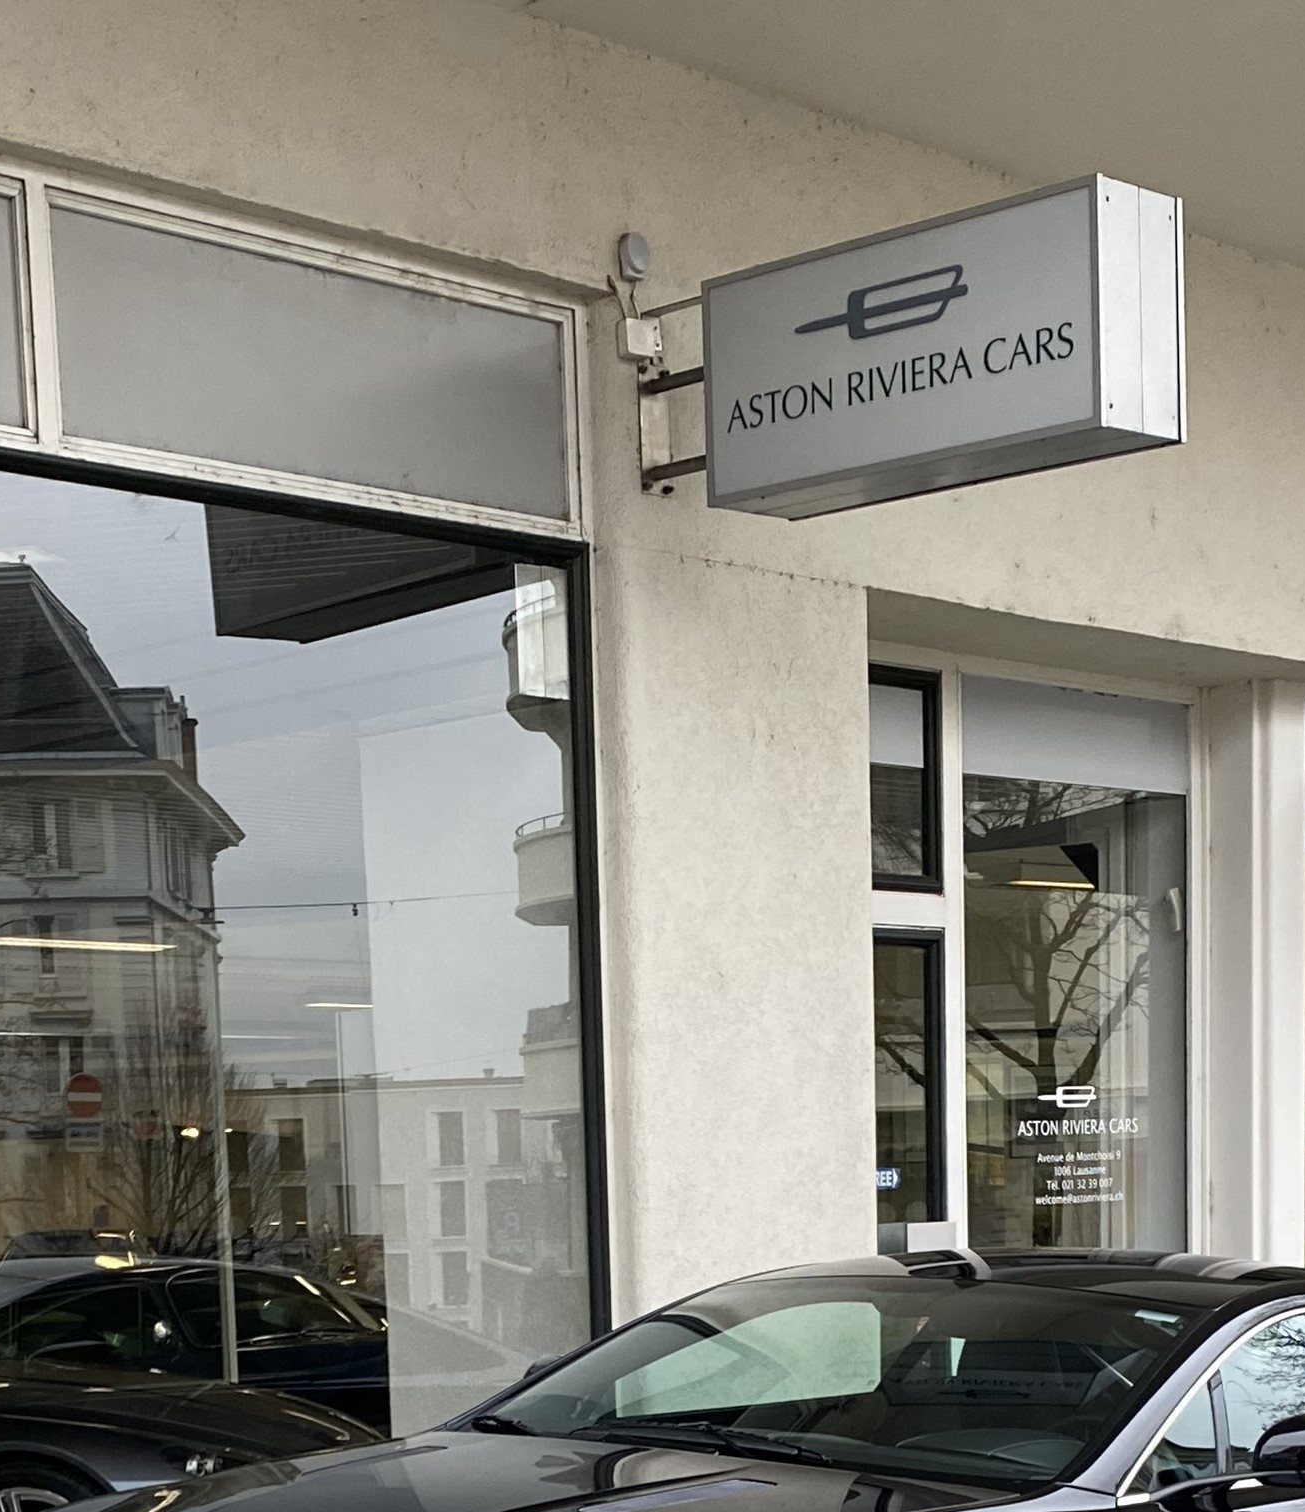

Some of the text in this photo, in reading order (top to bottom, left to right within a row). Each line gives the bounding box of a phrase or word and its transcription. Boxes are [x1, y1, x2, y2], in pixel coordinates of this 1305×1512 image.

[727, 321, 1075, 434] ASTON RIVIERA CARS
[1017, 1117, 1139, 1137] ASTON RIVIERA CARS
[1037, 1152, 1064, 1163] Avenue
[1065, 1152, 1075, 1162] de
[1116, 1150, 1122, 1160] 9
[1054, 1166, 1106, 1176] 1006 Lausanne
[1061, 1180, 1074, 1190] 021
[1077, 1179, 1086, 1189] 32
[1088, 1179, 1097, 1189] 39
